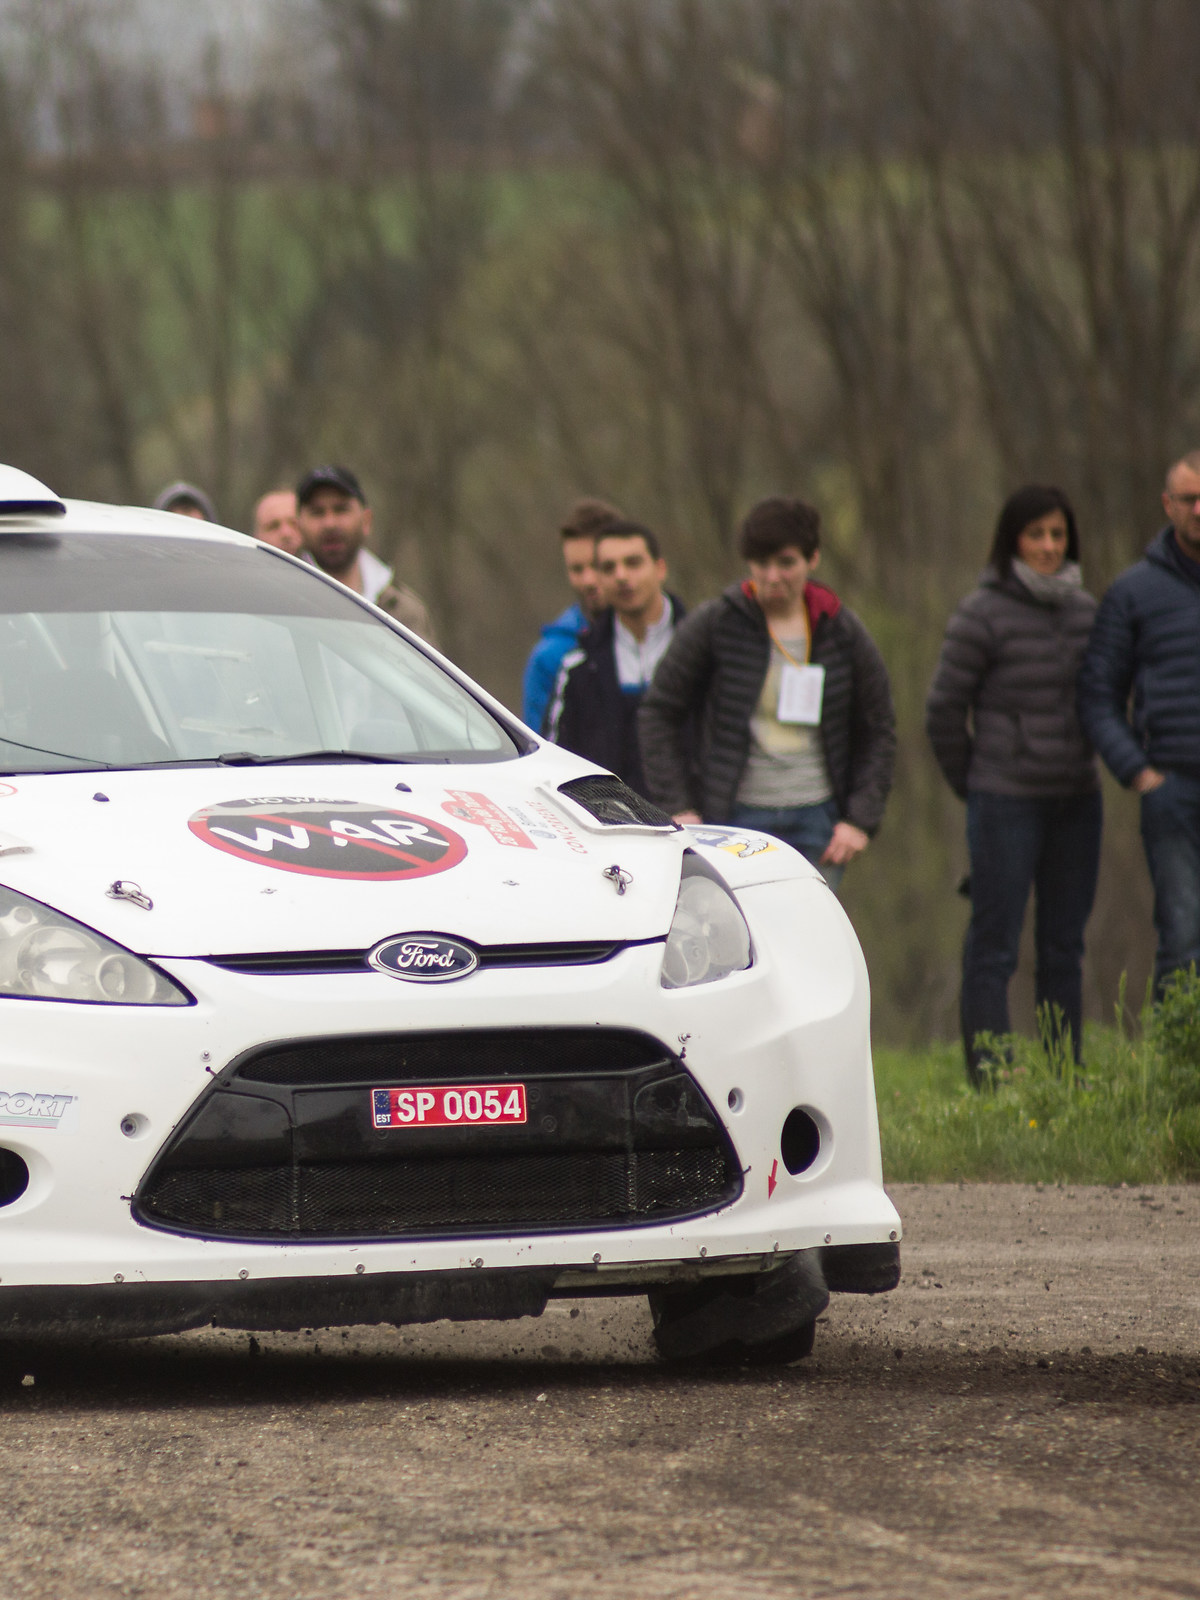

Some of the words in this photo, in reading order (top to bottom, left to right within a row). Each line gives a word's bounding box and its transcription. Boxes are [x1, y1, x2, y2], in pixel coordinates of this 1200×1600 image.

[209, 819, 451, 852] WAR
[397, 942, 456, 968] Ford
[376, 1113, 392, 1123] EST
[397, 1092, 436, 1123] SP
[443, 1089, 522, 1121] 0054
